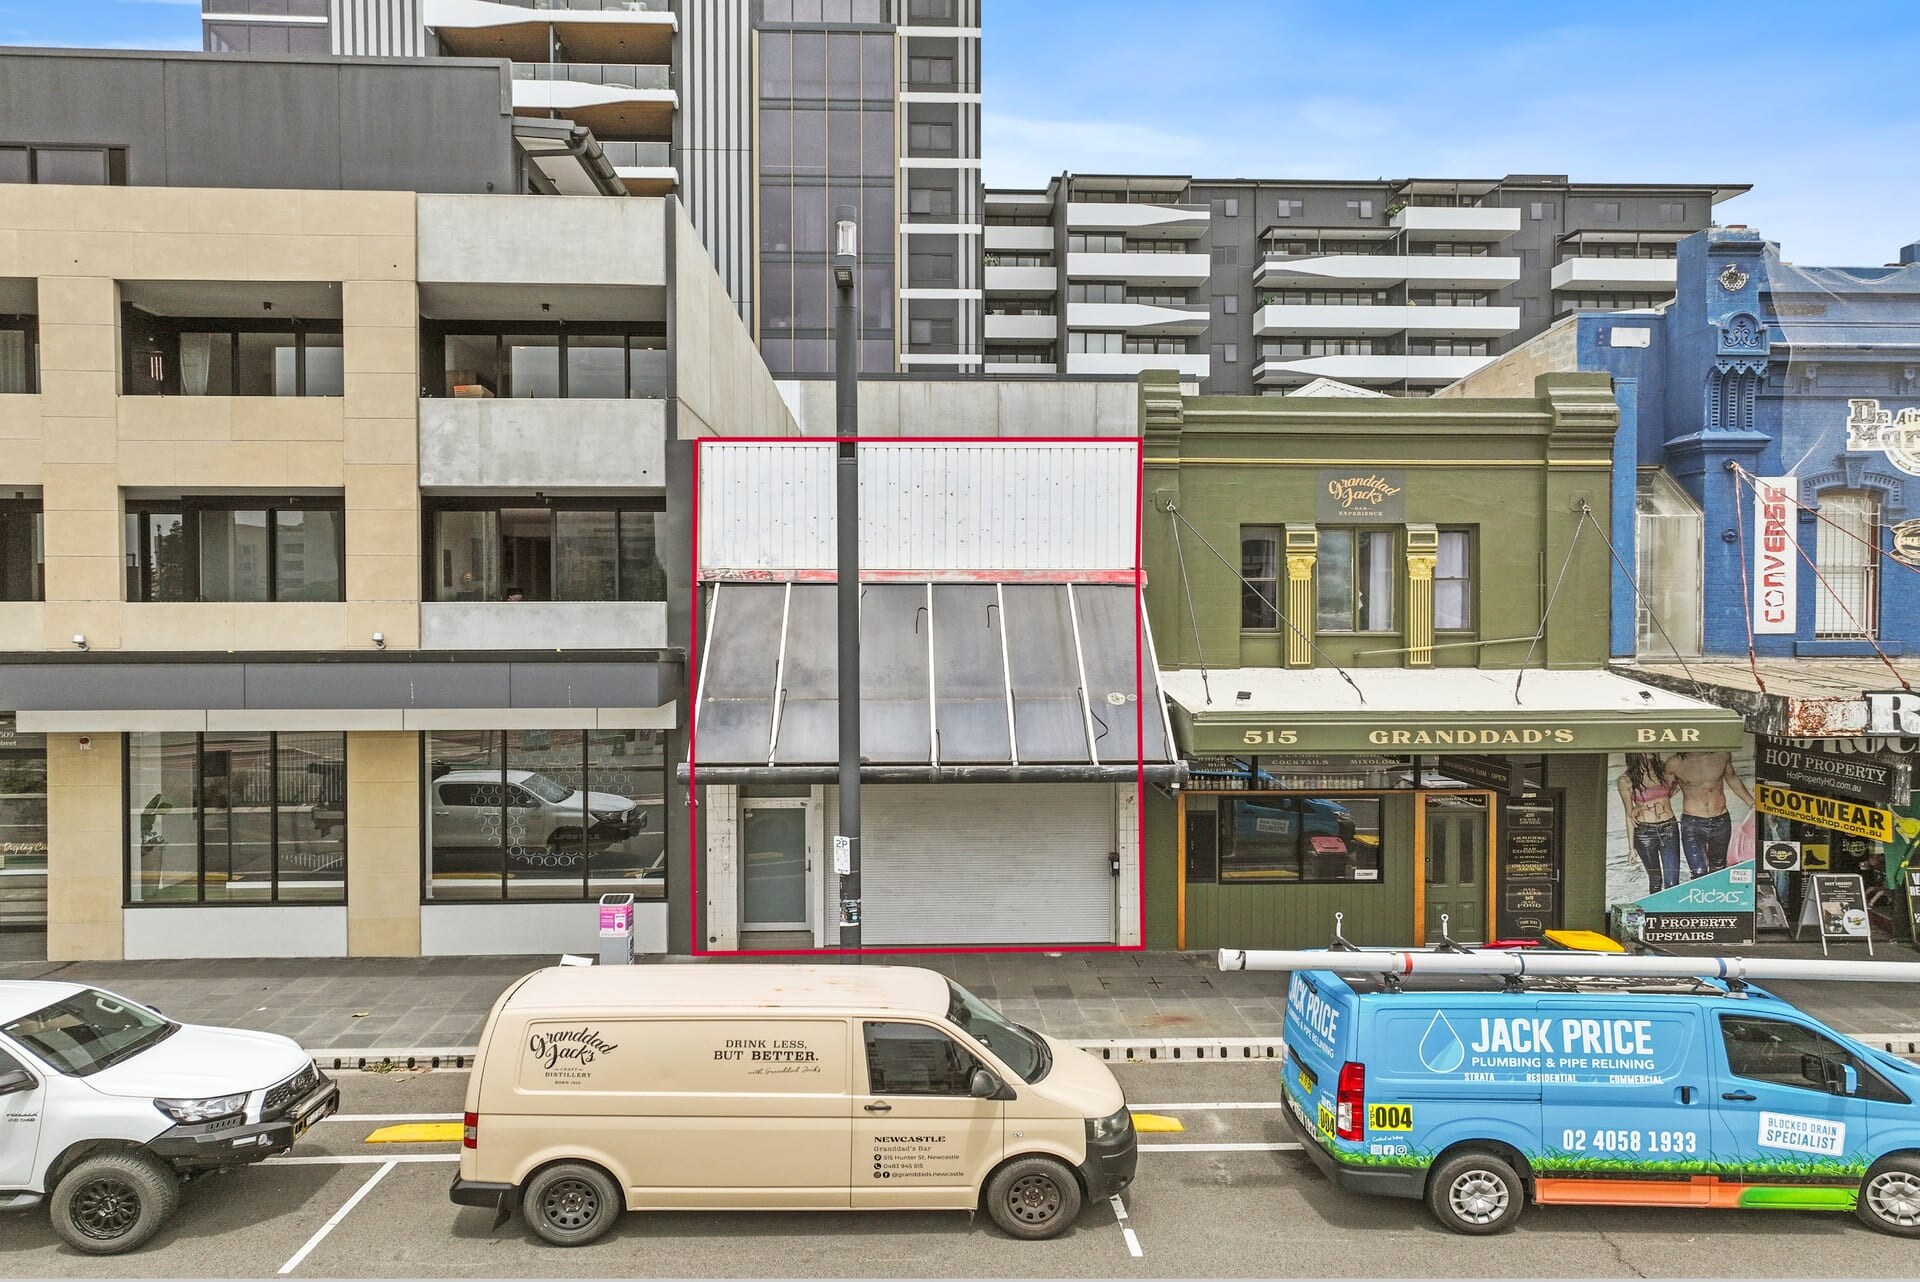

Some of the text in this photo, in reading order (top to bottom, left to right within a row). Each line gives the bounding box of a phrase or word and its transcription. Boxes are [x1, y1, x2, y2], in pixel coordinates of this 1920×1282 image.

[1329, 475, 1400, 500] Granddad
[1764, 487, 1787, 624] CONVERSE
[1243, 728, 1700, 744] 515 GRANDDAD'S BAR
[1764, 749, 1887, 783] HOT PROPERTY
[1786, 770, 1862, 792] HotPropertyHQ.com.au
[1759, 786, 1885, 831] FOOTWEAR
[1762, 803, 1882, 838] famousrockshop.com.au
[836, 840, 848, 848] 2P
[1660, 918, 1738, 928] PROPERTY
[1645, 931, 1714, 941] UPSTAIRS
[1306, 992, 1340, 1044] PRICE
[529, 1027, 618, 1059] Granddad
[725, 1039, 807, 1049] DRINK LESS,
[1471, 1017, 1654, 1055] JACK PRICE
[544, 1044, 596, 1069] Jack's
[714, 1050, 819, 1061] BUT BETTER.
[1472, 1057, 1655, 1069] PLUMBING & PIPE RELINING
[1464, 1072, 1495, 1082] STRATA
[1526, 1073, 1578, 1083] RESIDENTIAL
[1609, 1074, 1664, 1085] COMMERCIAL
[1375, 1106, 1413, 1128] 004
[1768, 1117, 1837, 1136] BLOCKED DRAIN
[1562, 1129, 1697, 1153] 02 4058 1933
[1766, 1129, 1837, 1151] SPECIALIST
